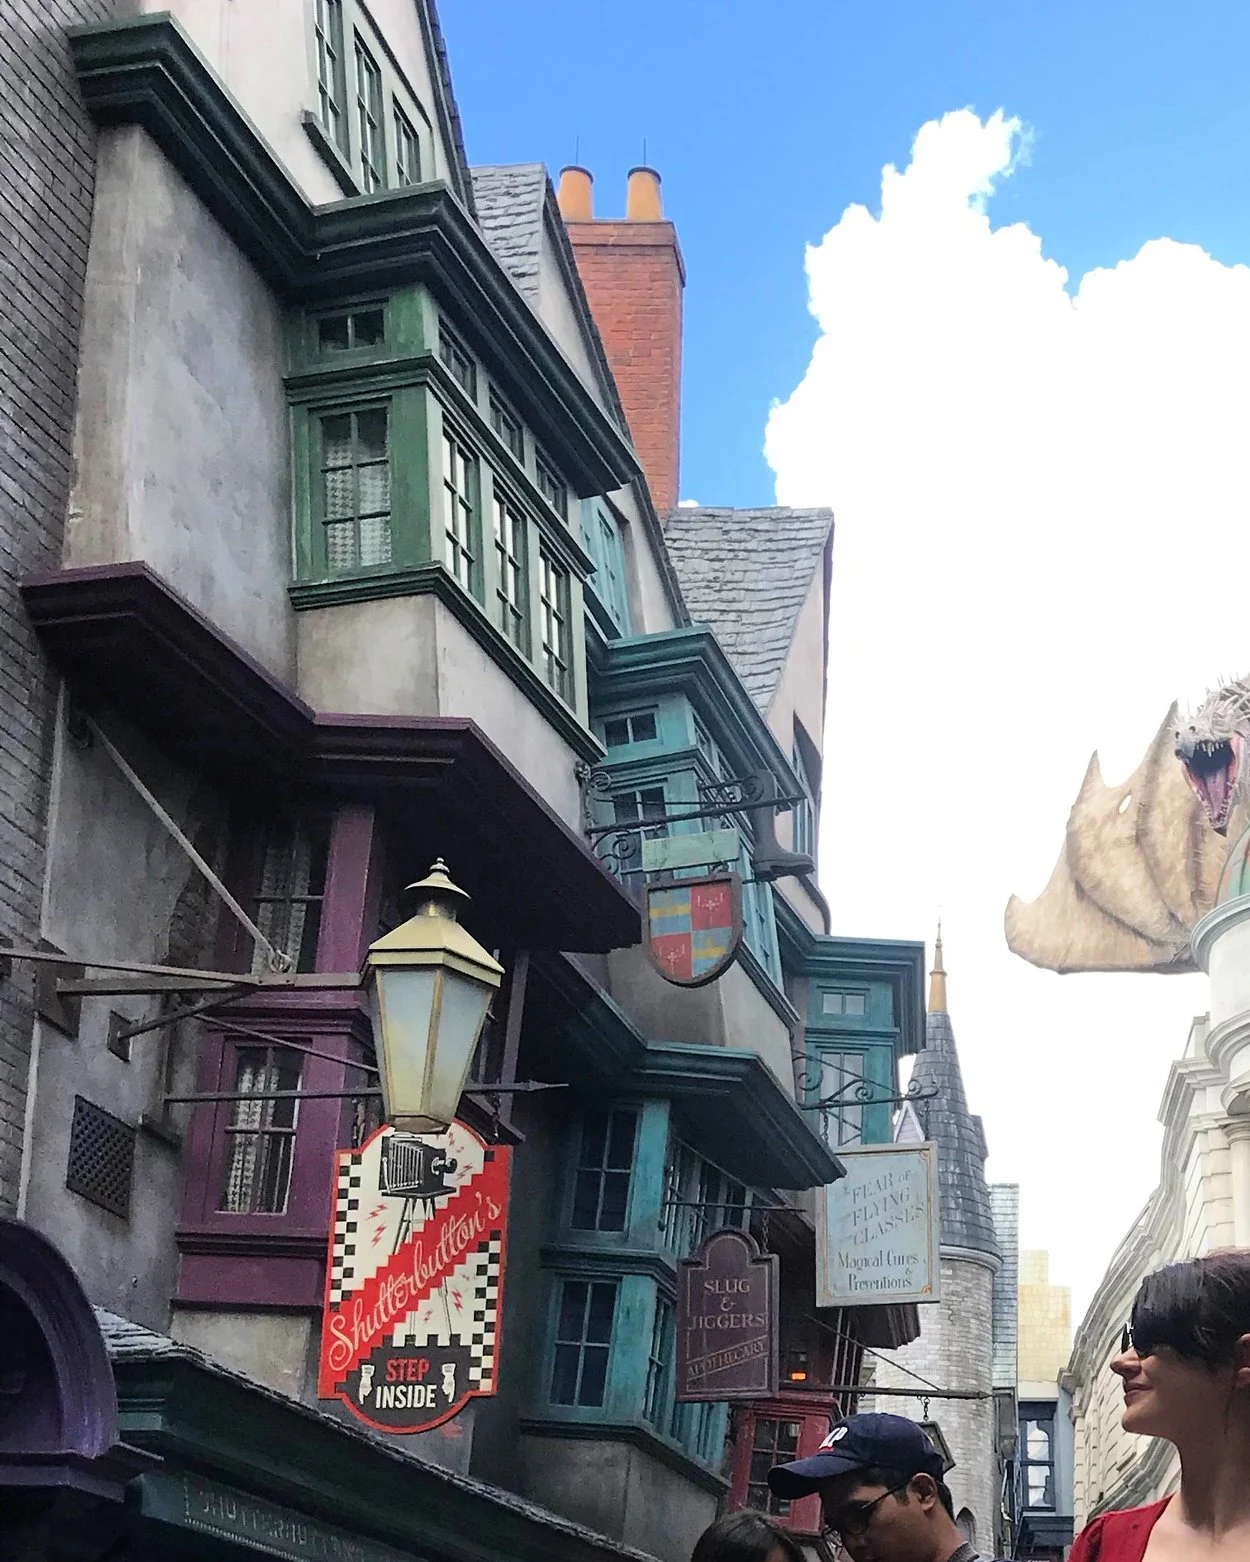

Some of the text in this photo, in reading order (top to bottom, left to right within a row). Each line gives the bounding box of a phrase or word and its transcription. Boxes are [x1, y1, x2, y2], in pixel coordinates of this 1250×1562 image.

[852, 1171, 894, 1205] FEAR
[852, 1186, 911, 1227] FLYING
[853, 1201, 925, 1247] CLASSES
[838, 1249, 920, 1271] Magical Cures
[328, 1191, 502, 1372] Shutterbutton's
[703, 1278, 751, 1294] SLUG
[848, 1273, 913, 1292] Preventions
[719, 1296, 737, 1312] &
[688, 1312, 766, 1331] JIGGERS
[385, 1358, 430, 1382] STEP
[375, 1384, 438, 1409] INSIDE
